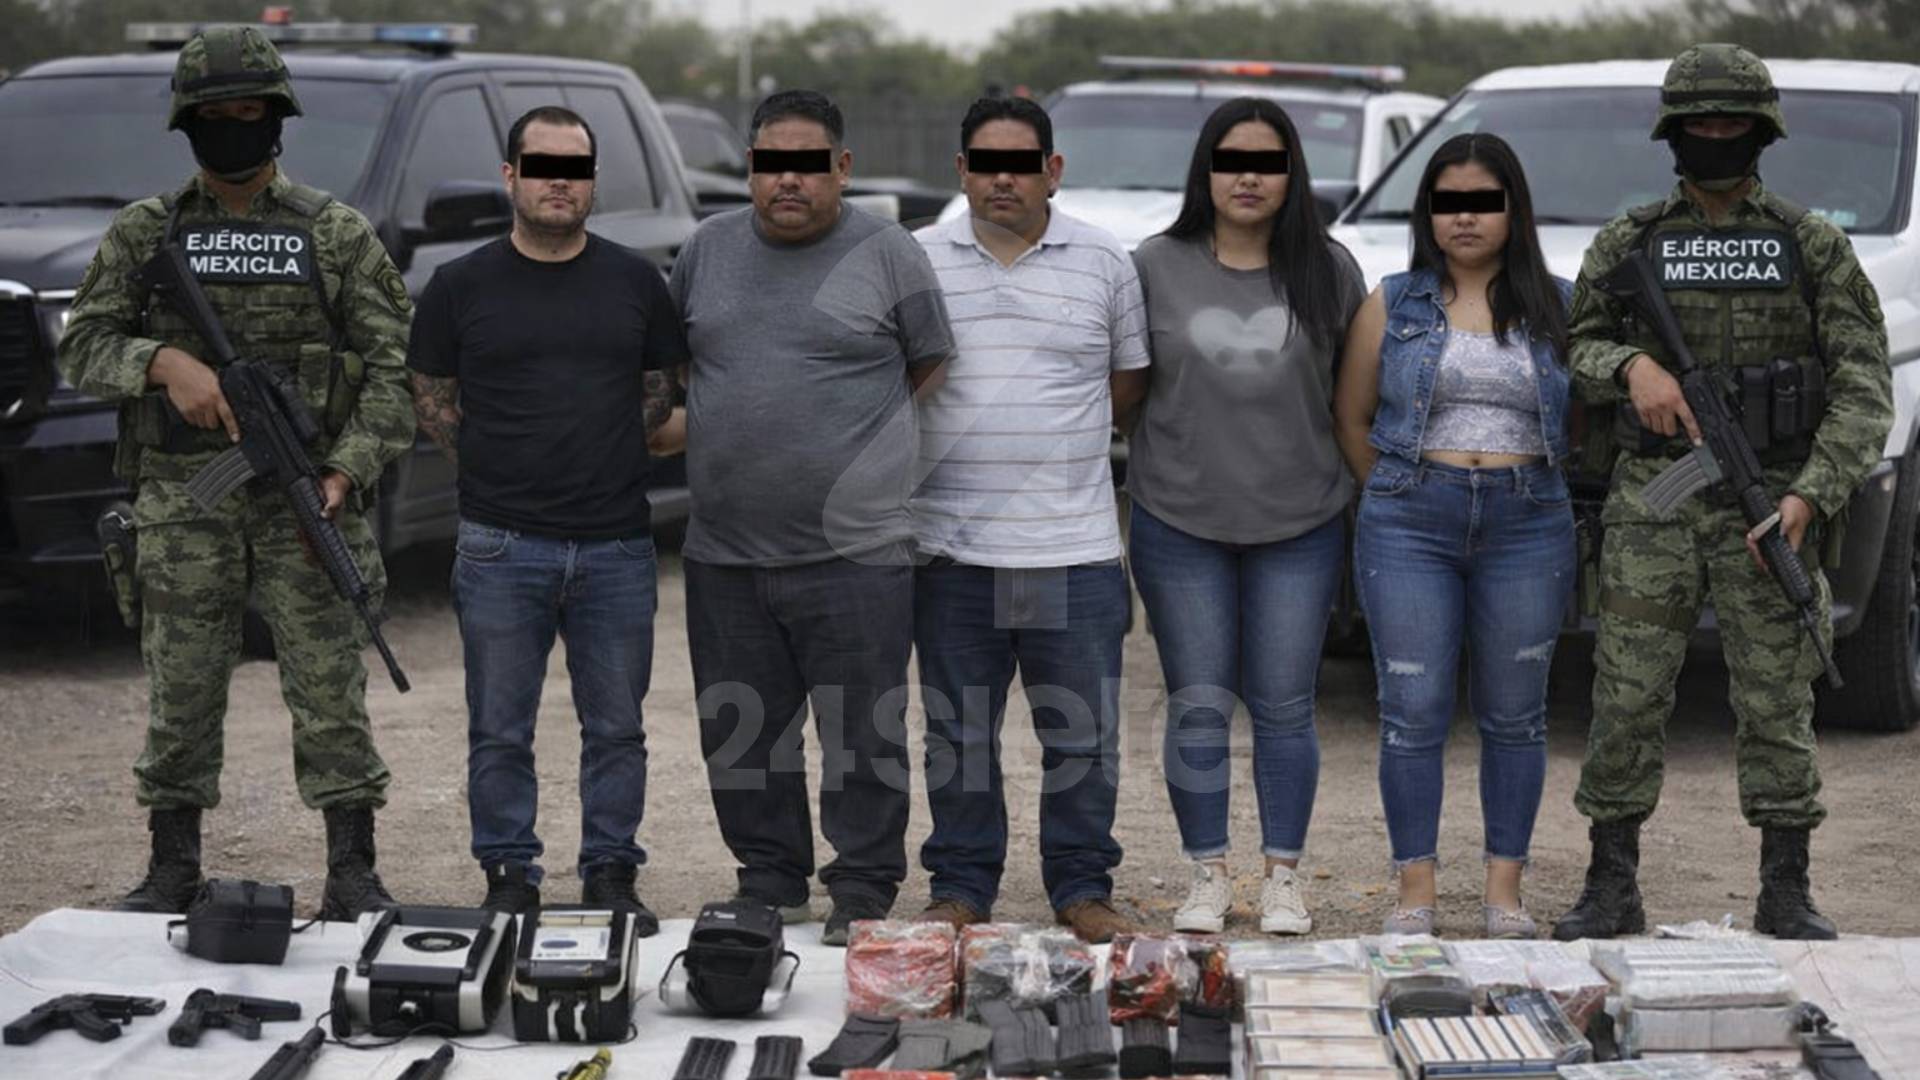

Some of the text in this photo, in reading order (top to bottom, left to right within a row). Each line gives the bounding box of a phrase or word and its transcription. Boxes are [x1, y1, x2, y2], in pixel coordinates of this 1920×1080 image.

[186, 228, 304, 253] EJÉRCITO
[1662, 235, 1781, 258] EJÉRCITO
[189, 255, 300, 275] MEXICLA
[1664, 262, 1781, 281] MEXICAA
